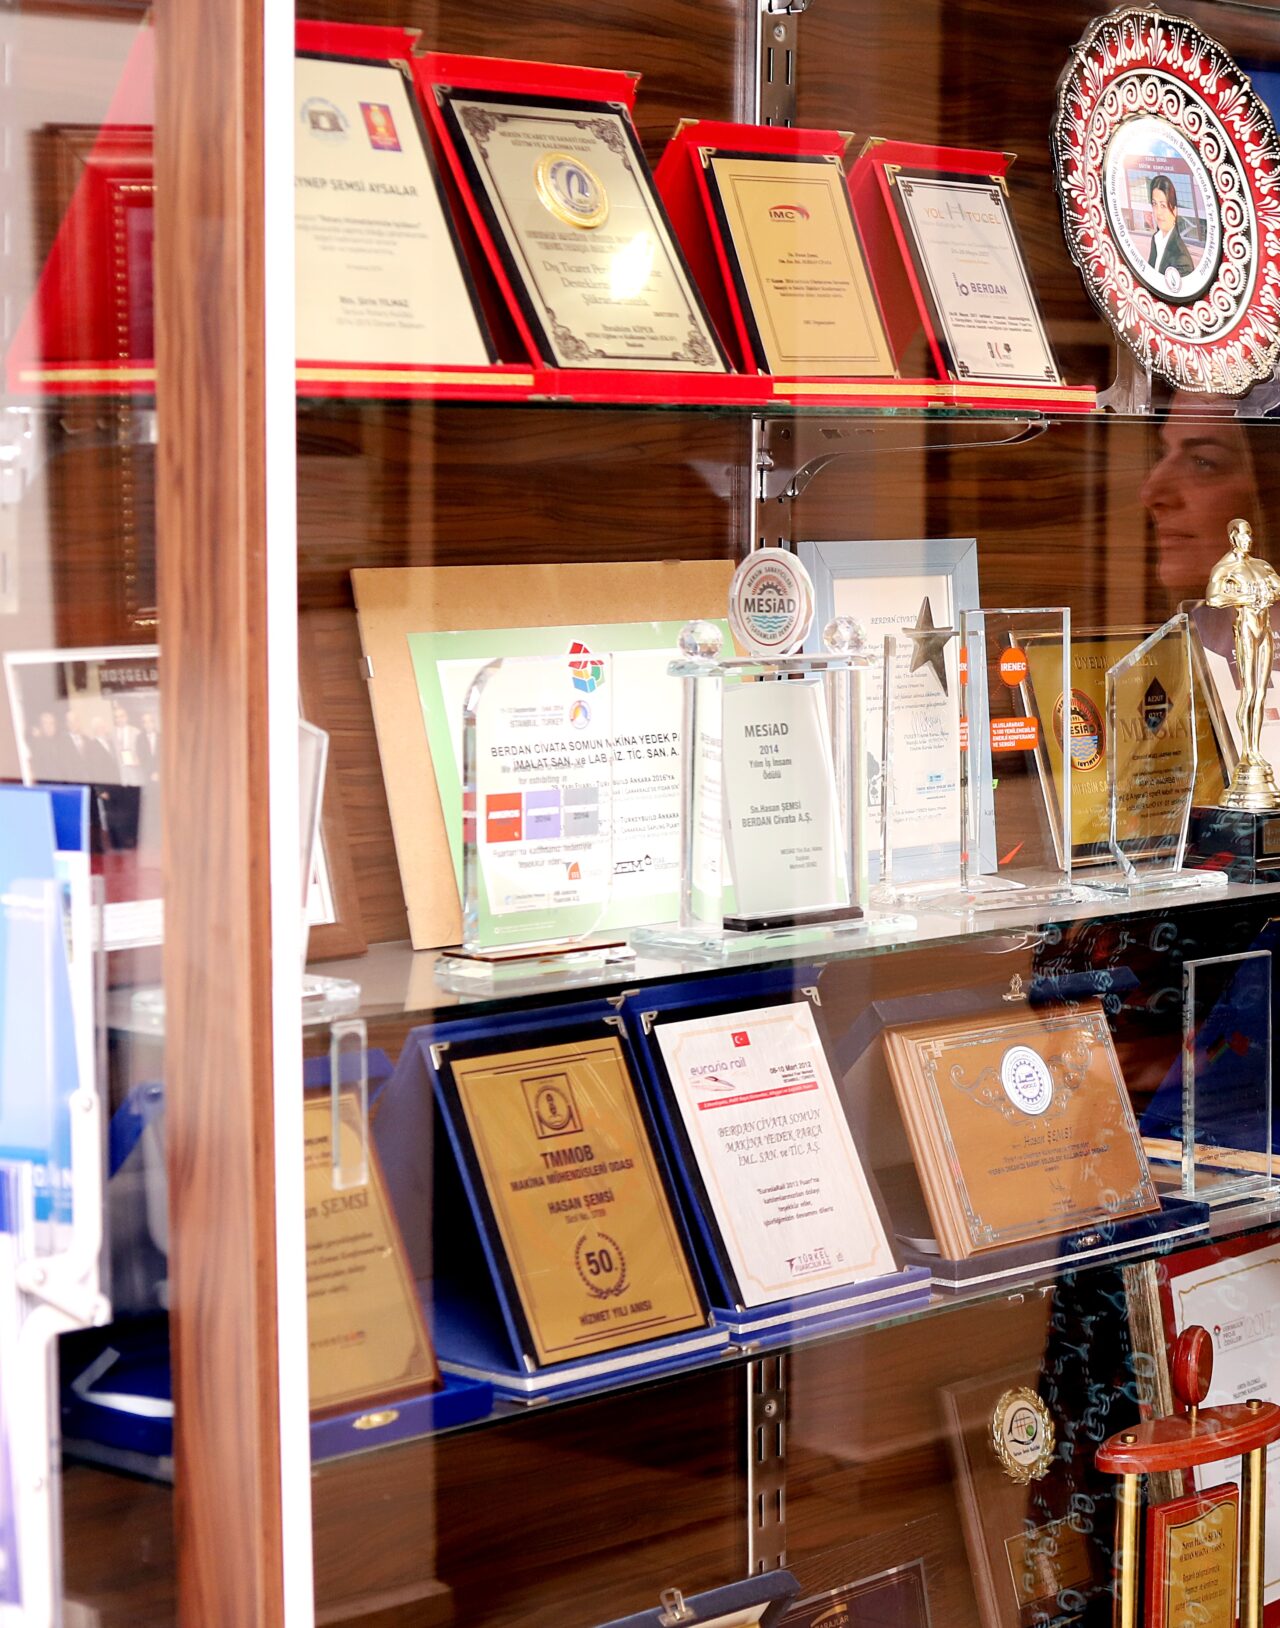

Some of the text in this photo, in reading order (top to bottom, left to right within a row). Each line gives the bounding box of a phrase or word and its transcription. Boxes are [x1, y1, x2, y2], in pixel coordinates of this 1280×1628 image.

[769, 211, 795, 219] IMC
[971, 282, 1008, 294] BERDAN
[1000, 662, 1026, 672] IRENEC
[491, 746, 531, 757] BERDAN
[534, 741, 567, 754] CİVATA
[569, 738, 603, 751] SOMUN
[639, 733, 670, 745] YEDEK
[760, 744, 779, 755] 2014
[742, 817, 772, 828] BERDAN
[774, 814, 796, 825] Civata
[690, 1056, 747, 1076] eurasia rail
[718, 1121, 755, 1138] BERDAN
[756, 1115, 788, 1131] CİVATA
[541, 1144, 595, 1170] TMMOB
[510, 1159, 634, 1192] MAKİNA MÜHENDİSLERİ ODASI
[547, 1187, 615, 1215] HASAN ŞEMSİ
[579, 1299, 652, 1326] HİZMET YILI ANISI
